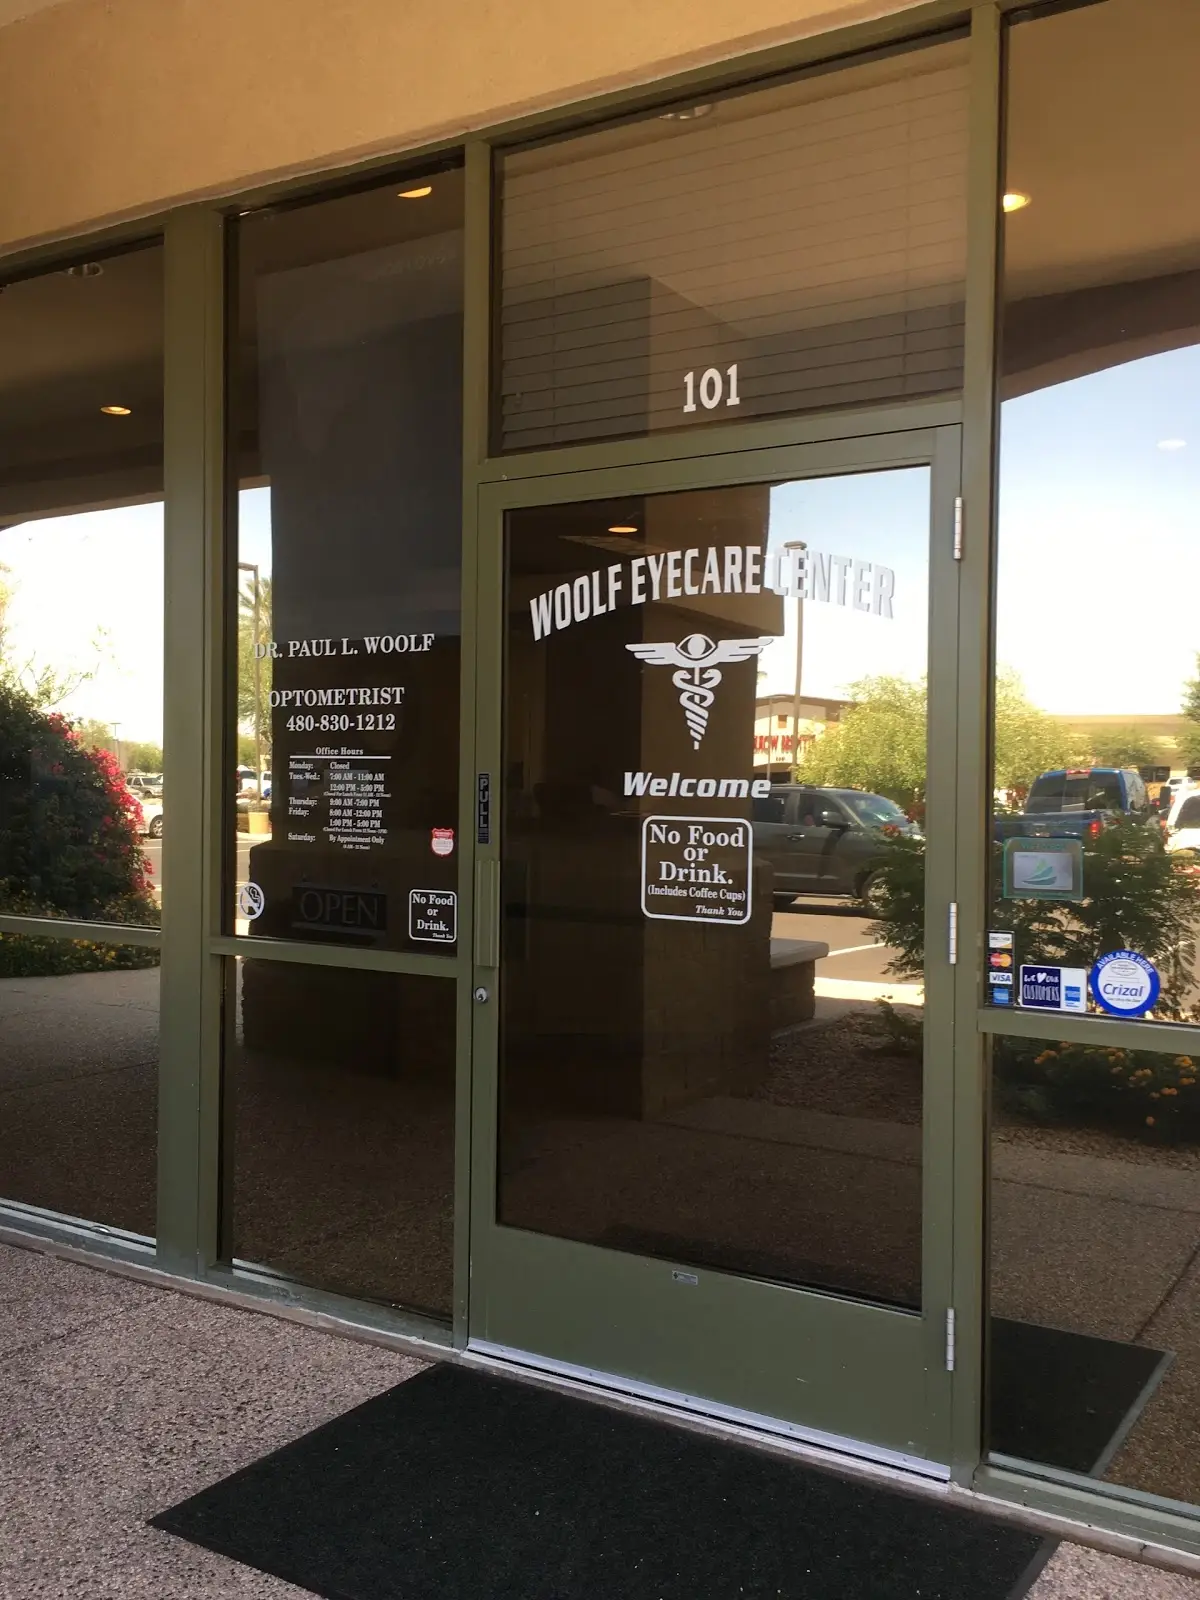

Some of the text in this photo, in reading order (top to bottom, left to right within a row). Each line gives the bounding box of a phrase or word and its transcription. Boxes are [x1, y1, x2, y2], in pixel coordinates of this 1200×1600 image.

[683, 363, 741, 413] 101
[529, 546, 896, 641] WOOLF EYECARE CENTER
[254, 633, 435, 659] DR. PAUL L. WOOLF
[269, 687, 405, 707] OPTOMETRIST
[286, 713, 396, 731] 480-830-1212
[316, 747, 363, 755] Office Hours
[289, 761, 314, 770] Monday:
[374, 773, 384, 781] AM
[624, 772, 771, 798] Welcome
[288, 797, 317, 806] Thursday:
[479, 778, 488, 828] PULL
[288, 808, 309, 817] Friday:
[342, 809, 352, 817] AM
[288, 833, 384, 845] Saturday: By Appointment Only
[650, 825, 744, 848] No Food
[683, 847, 708, 862] or
[659, 861, 733, 884] Drink.
[412, 893, 454, 906] No Food
[648, 884, 746, 902] (Includes Coffee Cups)
[300, 890, 378, 927] OPEN
[426, 907, 438, 917] or
[695, 904, 744, 916] Thank You
[416, 919, 449, 932] Drink.
[1096, 952, 1137, 970] AVAILABLE
[1136, 956, 1155, 974] HERE
[1023, 984, 1060, 1002] CUSTOMERS
[1103, 983, 1144, 997] Crizal
